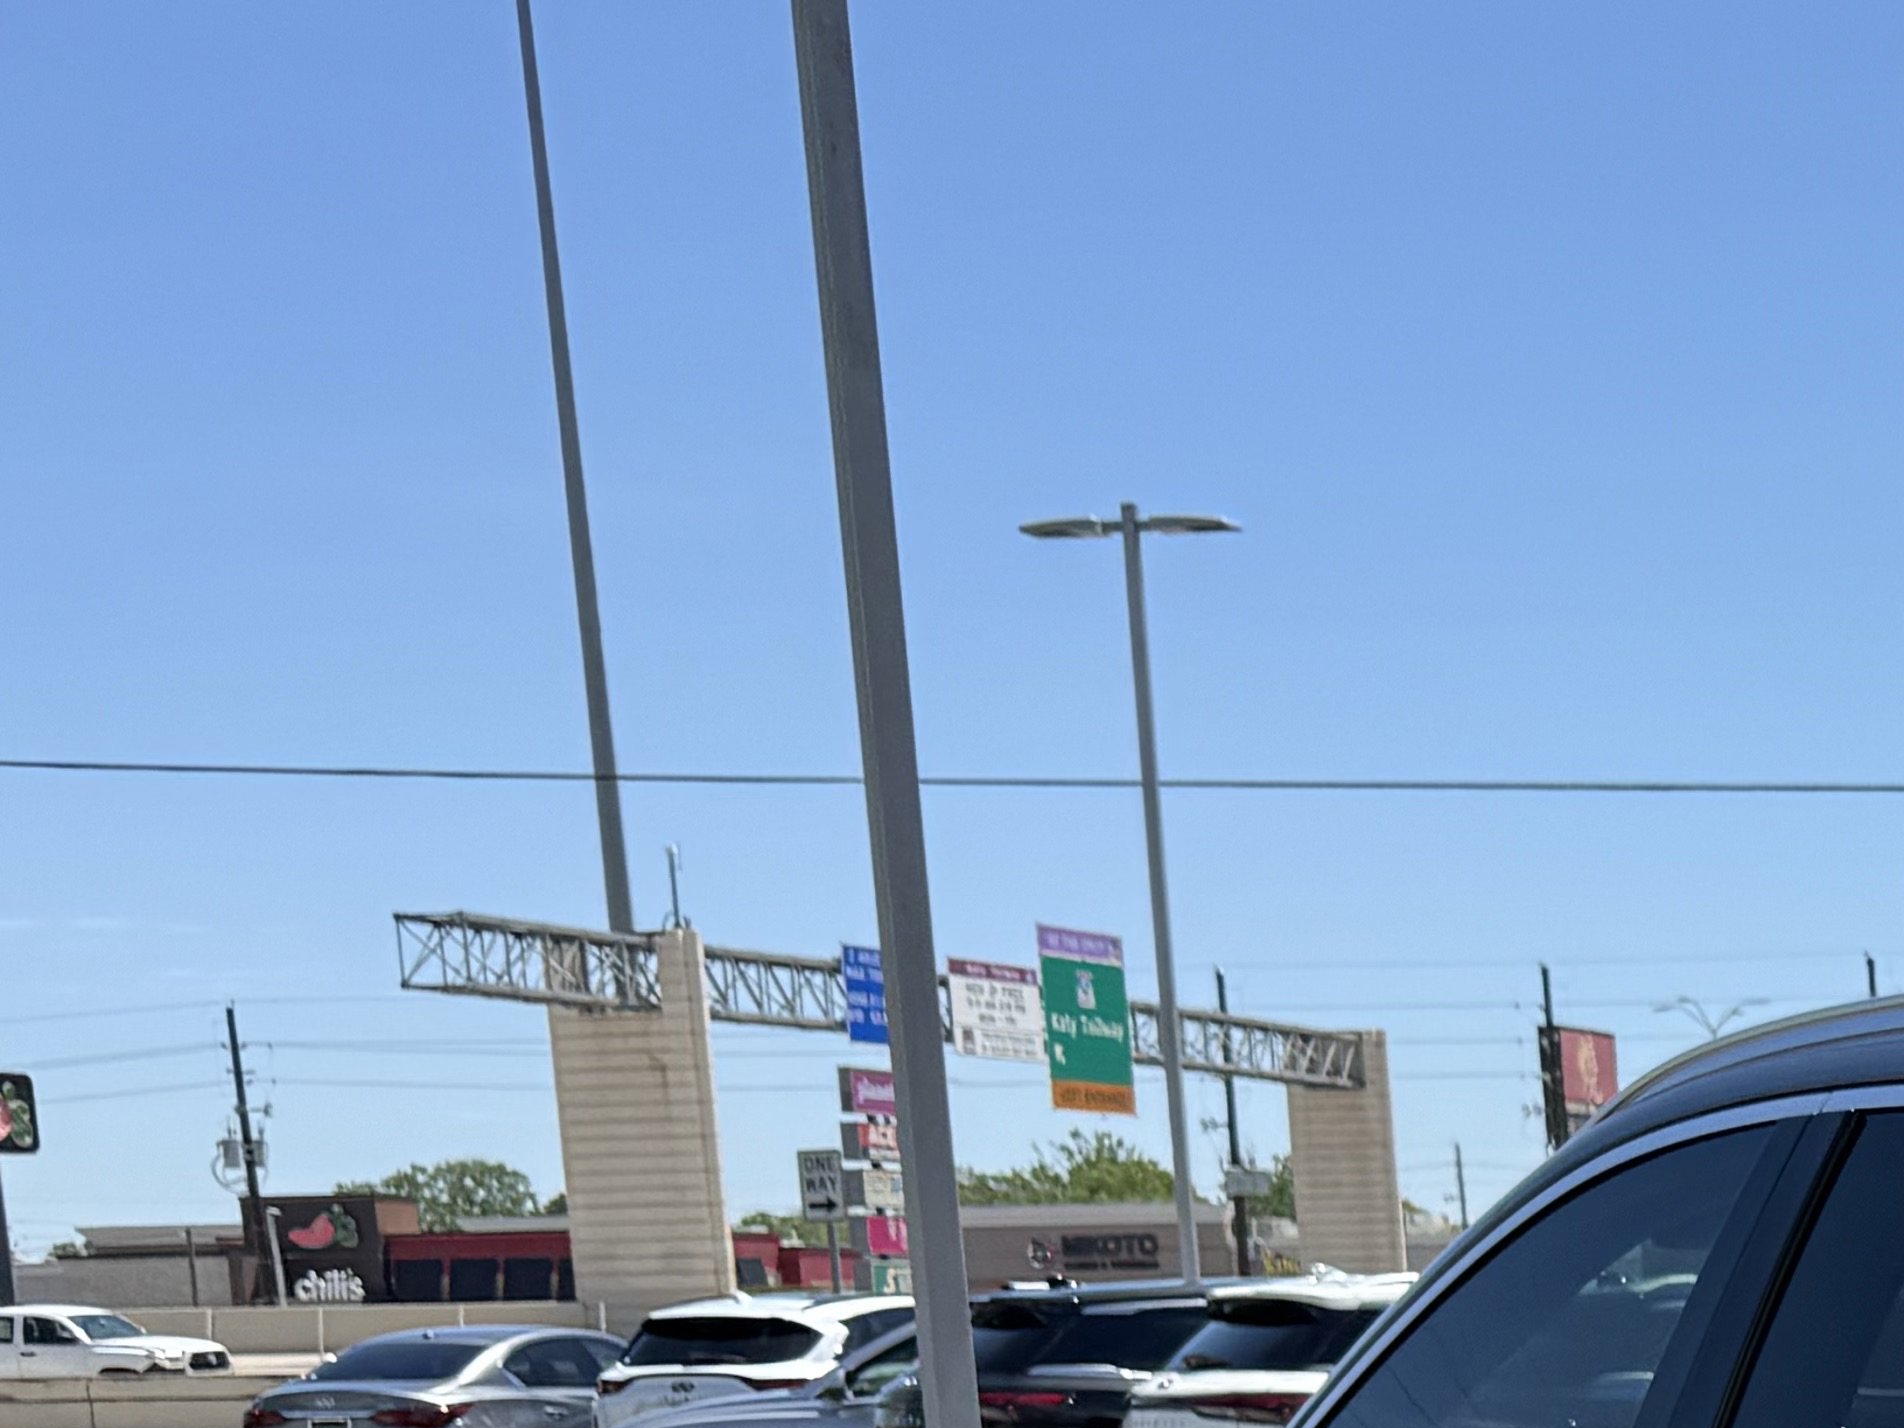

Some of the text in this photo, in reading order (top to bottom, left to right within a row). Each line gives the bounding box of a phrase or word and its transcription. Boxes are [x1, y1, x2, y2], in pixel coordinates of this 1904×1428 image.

[1051, 1012, 1077, 1040] Katy
[803, 1155, 837, 1172] ONE
[805, 1177, 837, 1194] WAY
